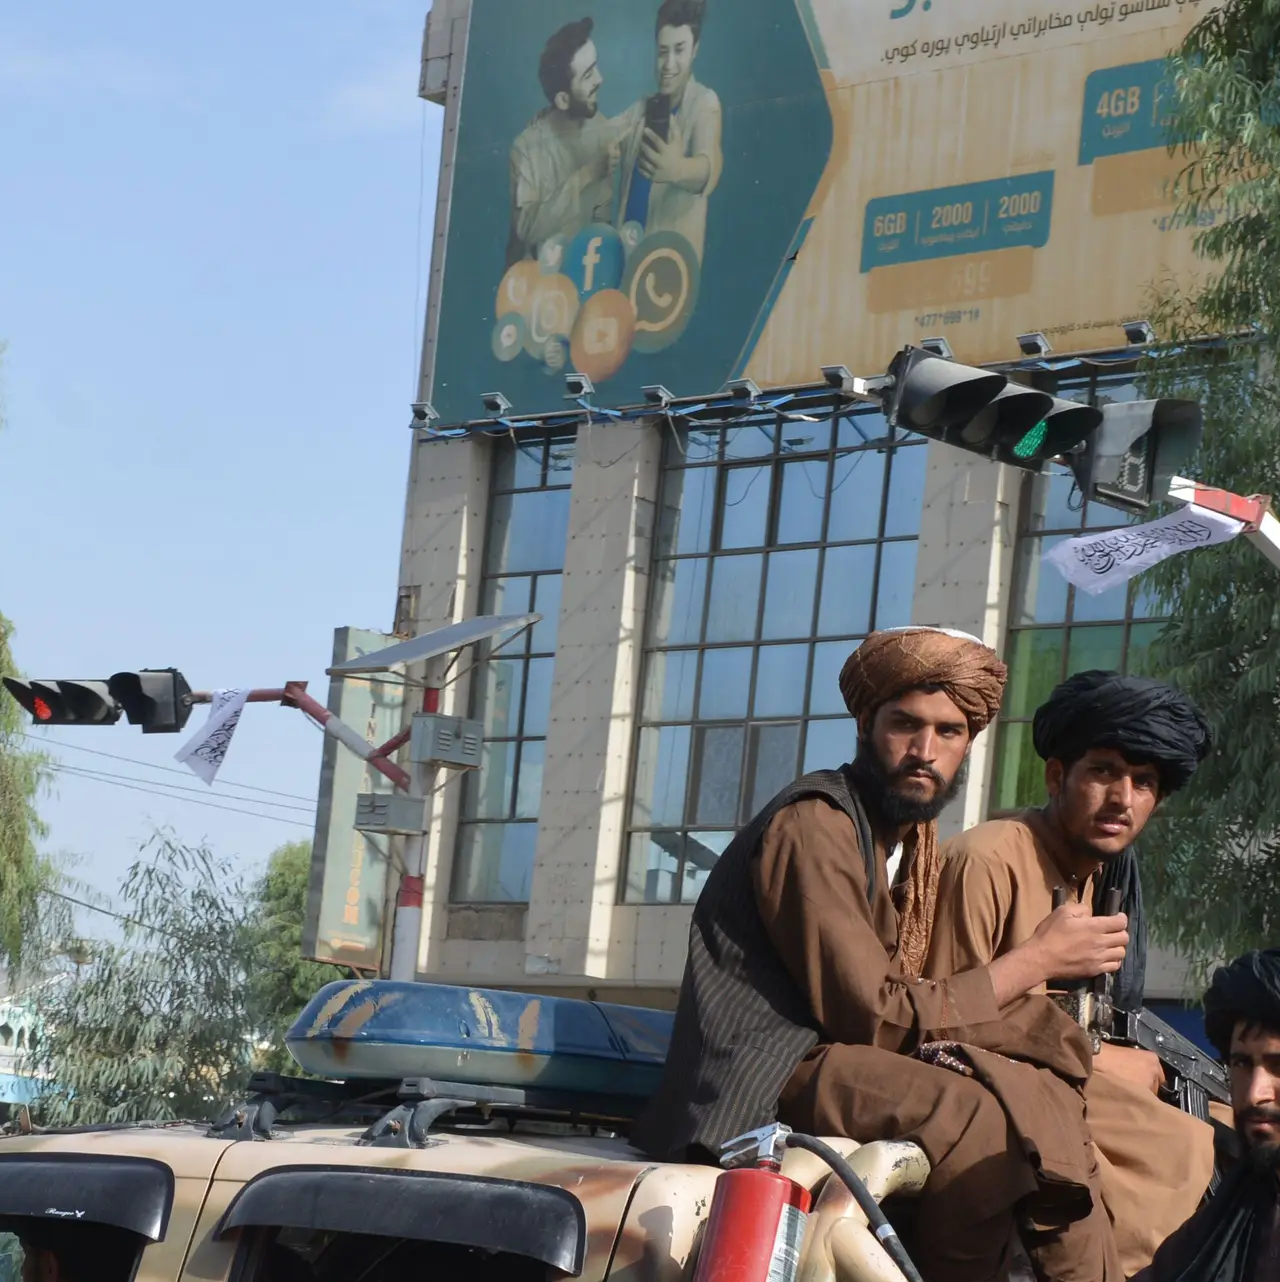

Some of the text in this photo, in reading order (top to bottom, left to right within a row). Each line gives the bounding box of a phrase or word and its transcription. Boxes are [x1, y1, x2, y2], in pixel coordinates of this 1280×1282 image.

[1096, 86, 1141, 118] 4GB
[874, 212, 907, 237] 6GB
[931, 202, 973, 228] 2000
[998, 191, 1041, 218] 2000
